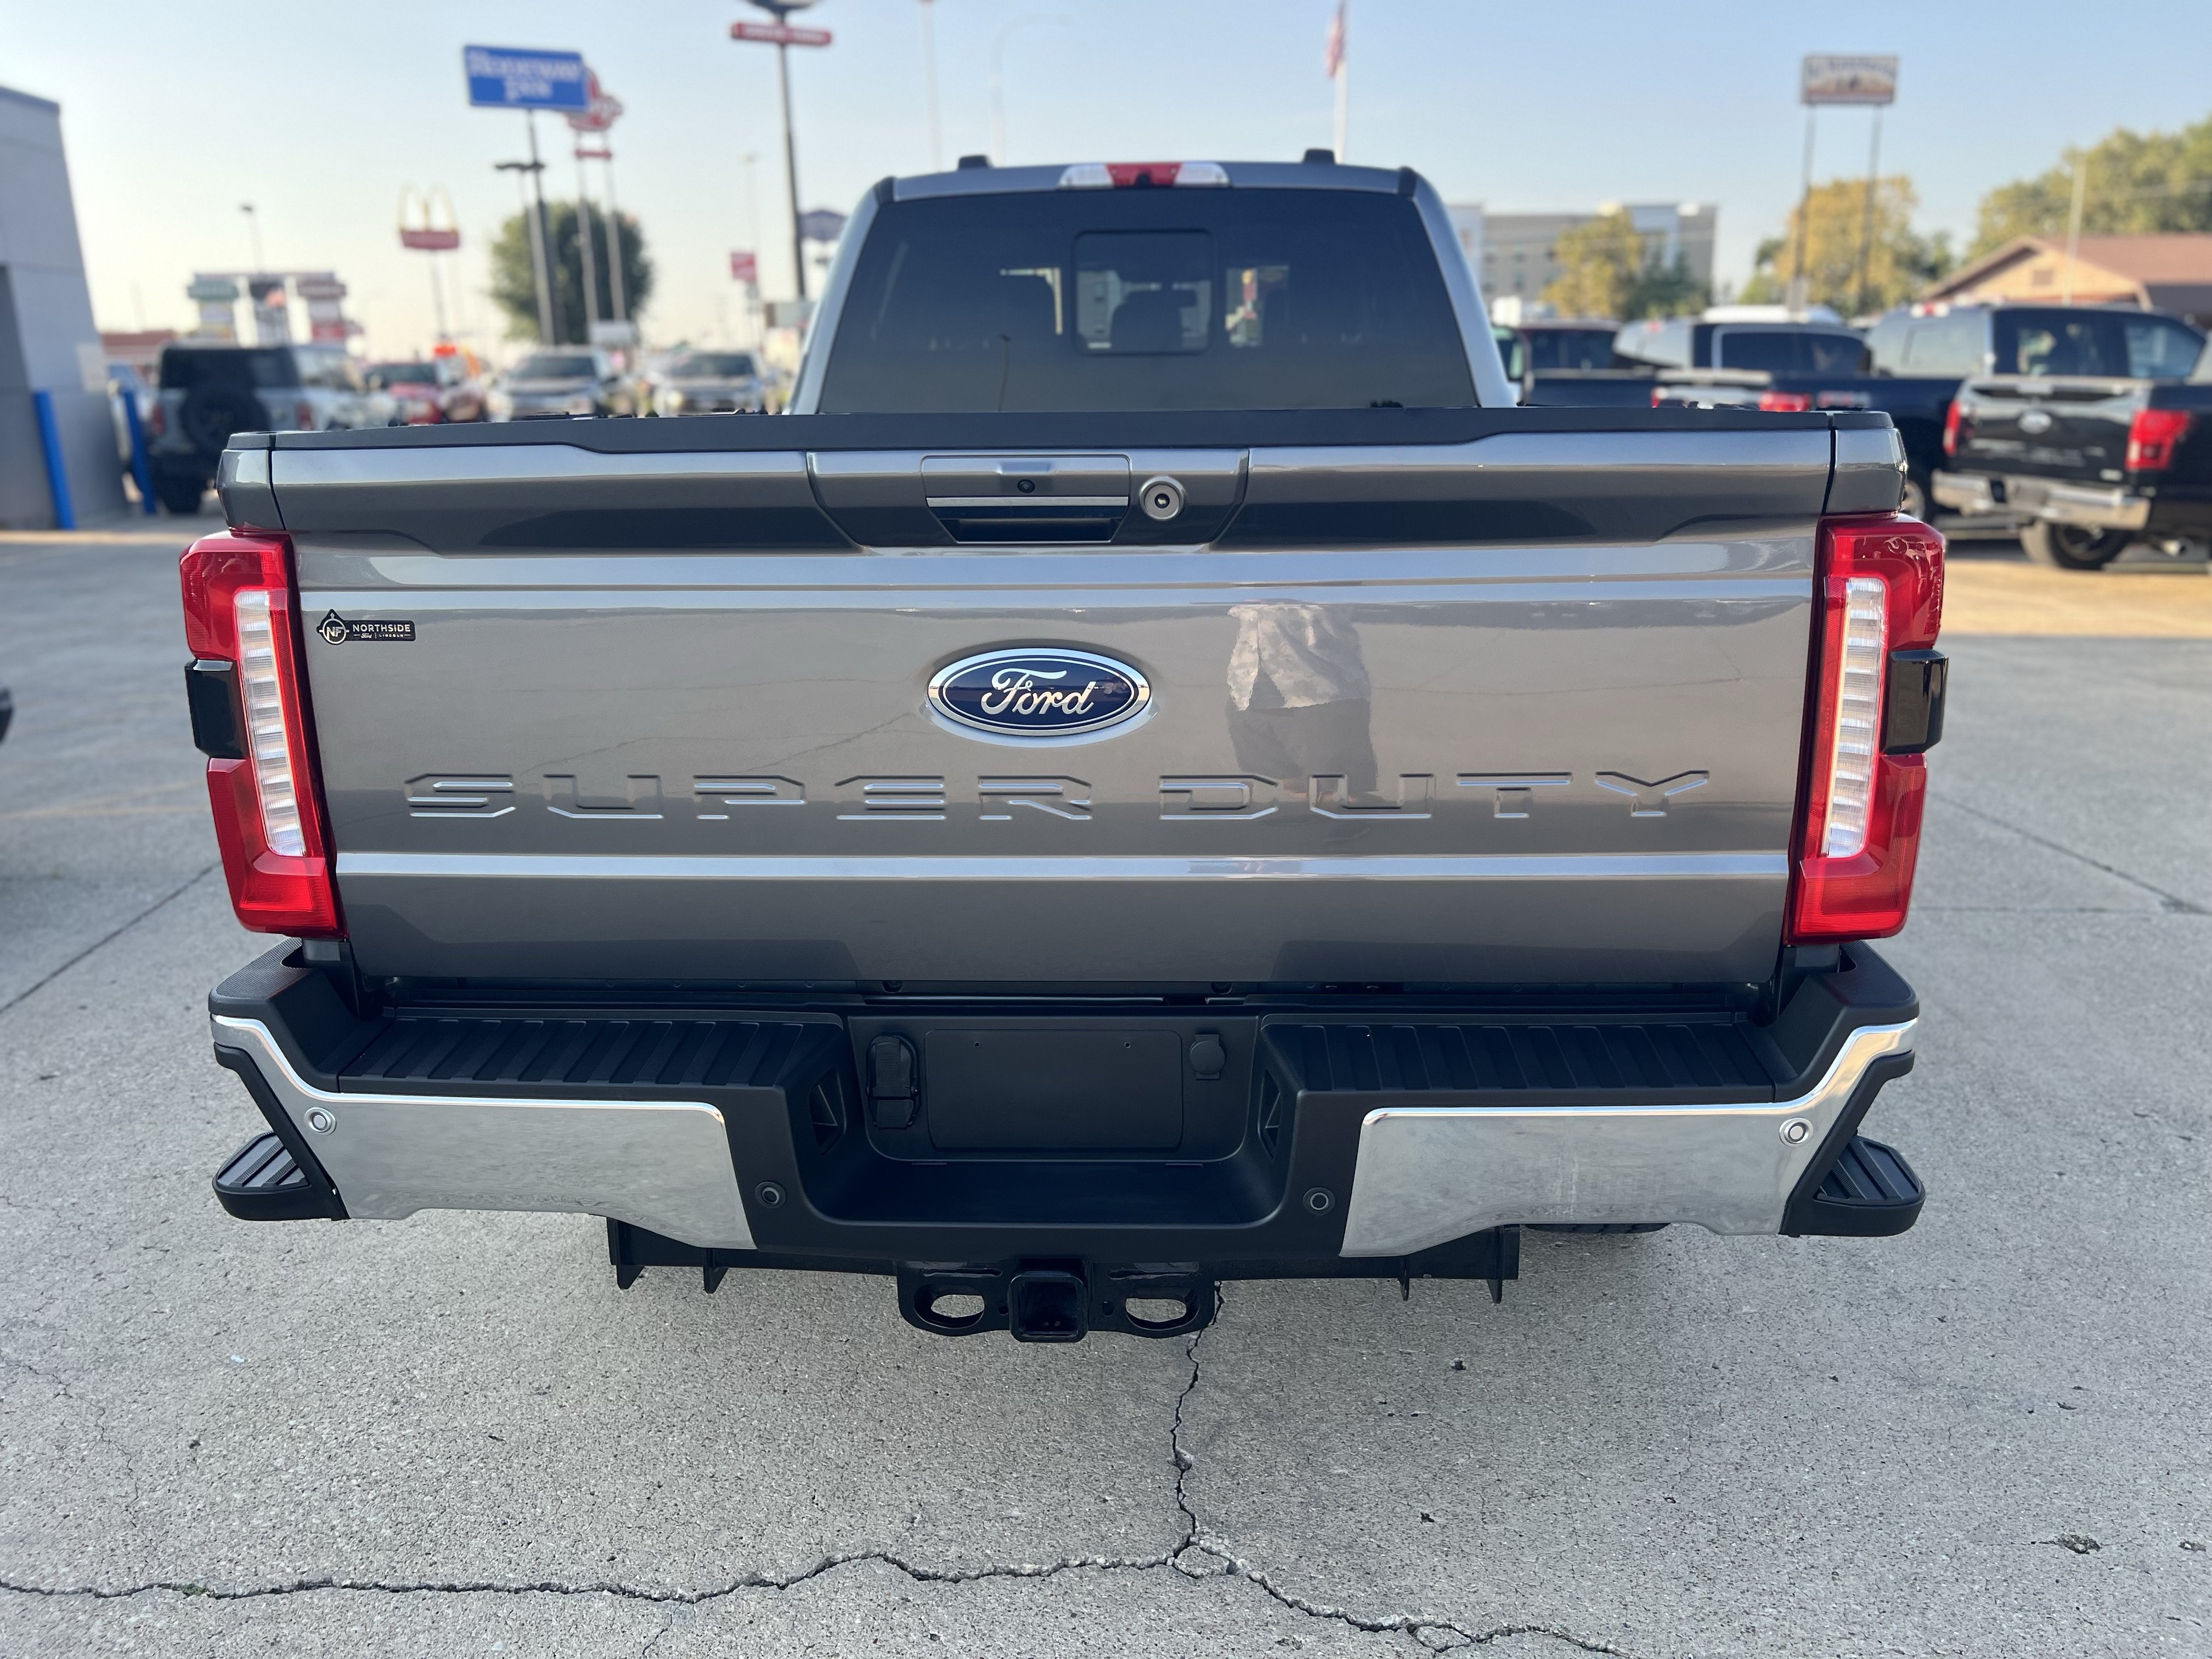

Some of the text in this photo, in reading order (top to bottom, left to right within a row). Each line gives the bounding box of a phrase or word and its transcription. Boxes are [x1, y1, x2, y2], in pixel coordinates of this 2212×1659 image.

[326, 626, 345, 641] NF
[353, 624, 411, 632] NORTHSIDE
[980, 668, 1096, 715] Ford
[404, 769, 1710, 821] SUPER DUTY
